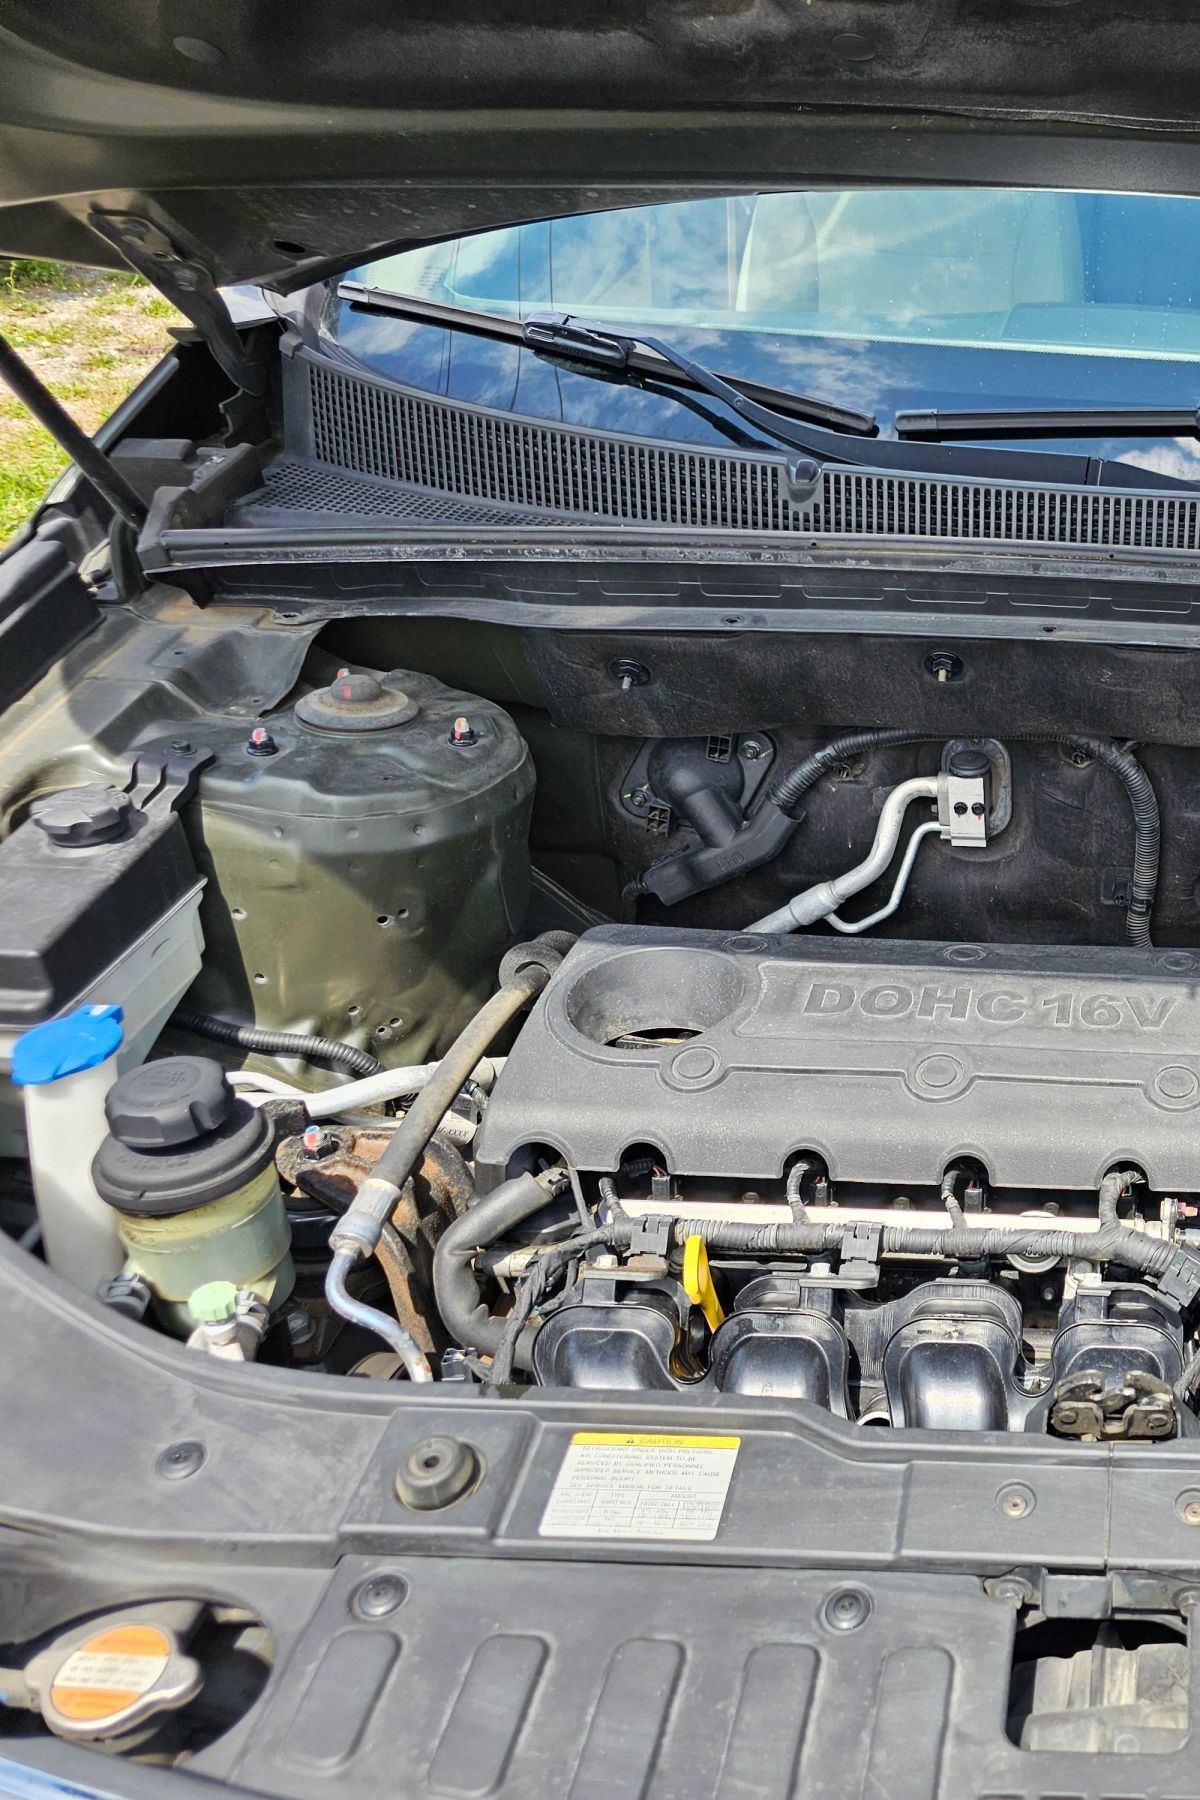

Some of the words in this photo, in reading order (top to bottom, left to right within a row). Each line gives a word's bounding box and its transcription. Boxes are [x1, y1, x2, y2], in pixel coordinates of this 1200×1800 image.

[803, 983, 1027, 1023] DOHC
[1041, 993, 1177, 1031] 16V
[639, 1437, 684, 1446] CAUTION
